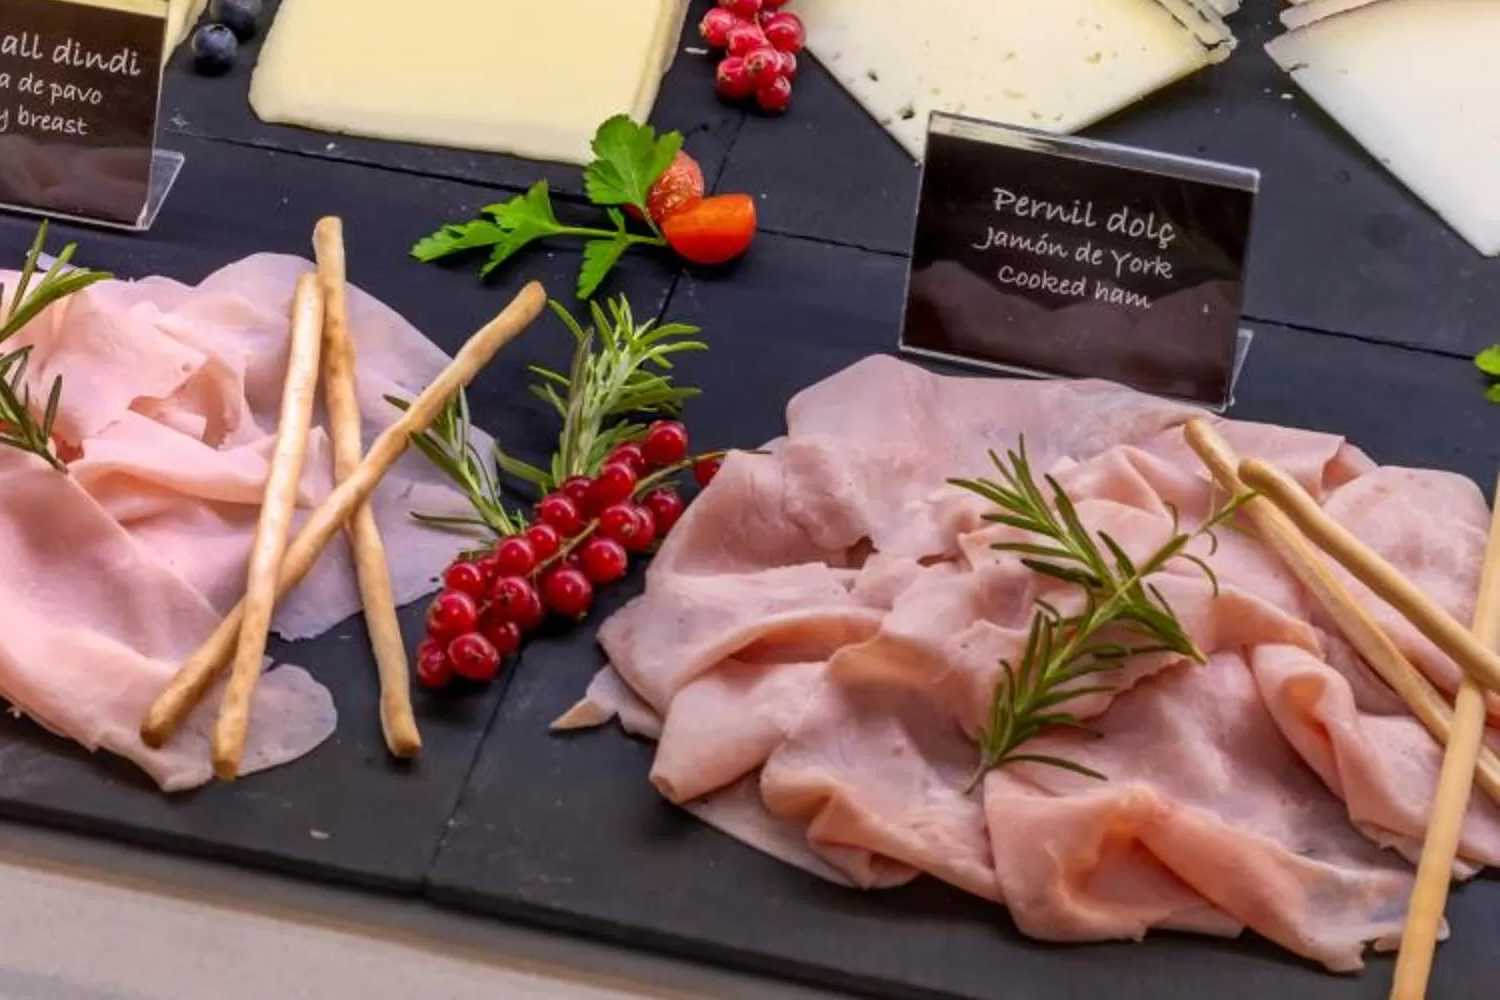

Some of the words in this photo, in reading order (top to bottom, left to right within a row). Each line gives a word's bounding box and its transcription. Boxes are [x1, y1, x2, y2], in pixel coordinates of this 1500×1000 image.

[52, 37, 142, 77] dindi
[17, 72, 45, 95] de
[50, 81, 103, 107] pavo
[17, 104, 89, 136] breast
[992, 187, 1097, 228] Pernil
[1106, 206, 1177, 249] dolç
[971, 226, 1069, 259] Jamón
[1075, 242, 1104, 266] de
[1111, 249, 1173, 280] York
[998, 265, 1087, 298] Cooked
[1094, 280, 1152, 309] ham
